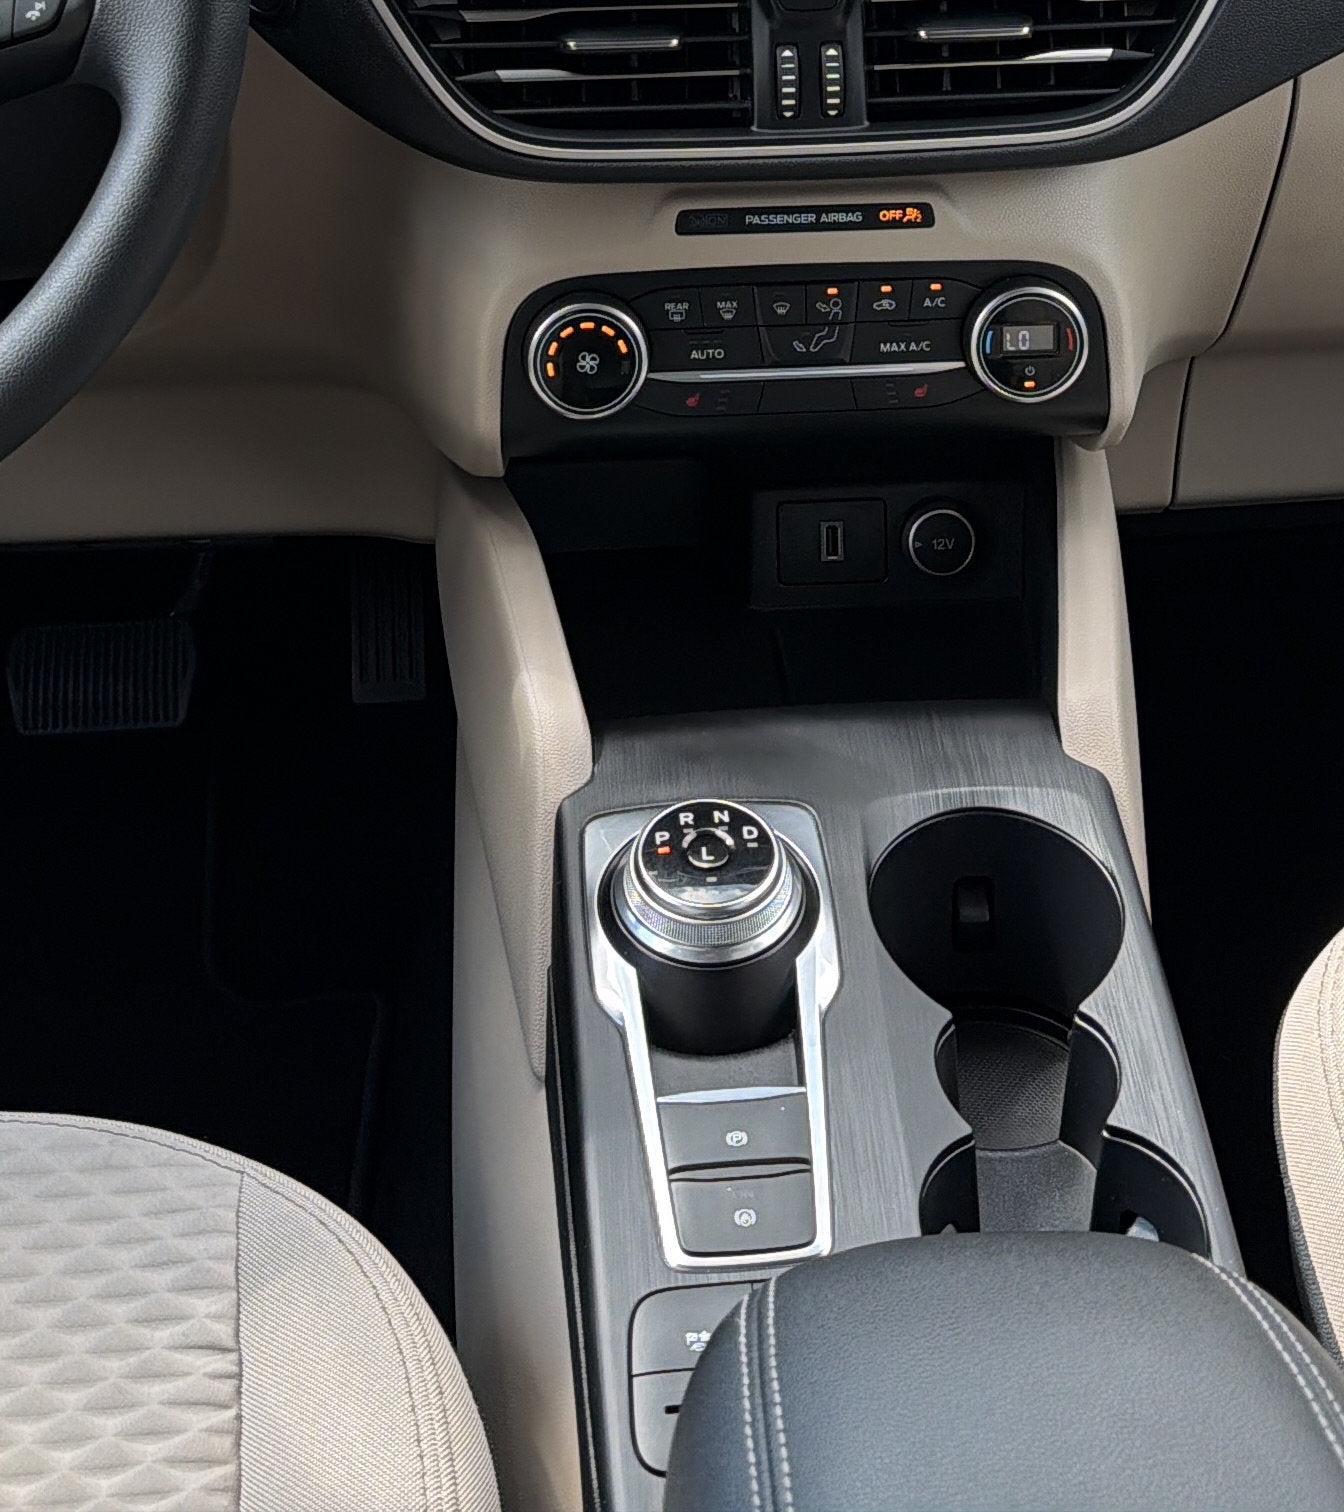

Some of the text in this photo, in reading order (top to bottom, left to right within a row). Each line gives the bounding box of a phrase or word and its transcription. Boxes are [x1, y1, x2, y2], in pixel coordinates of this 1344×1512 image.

[744, 209, 904, 226] PASSENGER AIRBAG OFF
[664, 301, 690, 311] REAR
[716, 299, 739, 310] MAX
[922, 296, 947, 309] A/C
[878, 339, 932, 354] MAX A/C
[1005, 329, 1031, 351] LO
[689, 348, 726, 361] AUTO
[932, 538, 955, 550] 12V
[655, 810, 758, 845] P R N D
[701, 846, 714, 860] L
